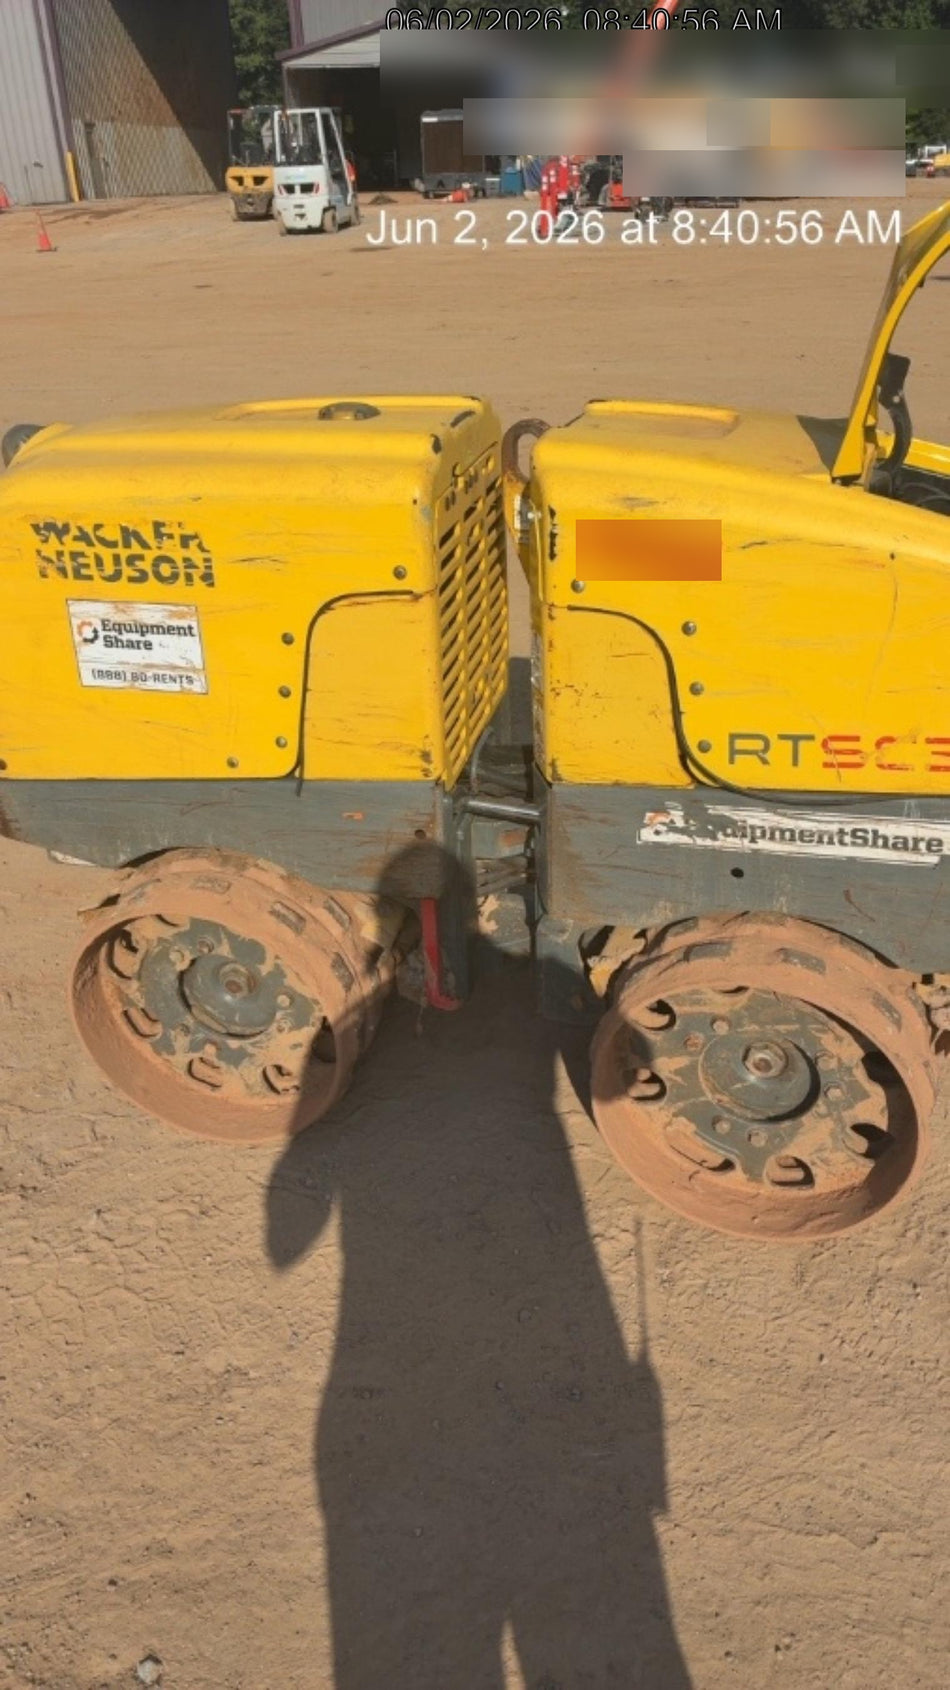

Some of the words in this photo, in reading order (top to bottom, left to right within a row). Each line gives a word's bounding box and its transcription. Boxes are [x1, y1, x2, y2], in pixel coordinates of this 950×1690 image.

[35, 549, 215, 588] NEUSON
[101, 619, 196, 637] Equipment
[103, 634, 153, 651] Share
[695, 815, 944, 853] uipmentShare
